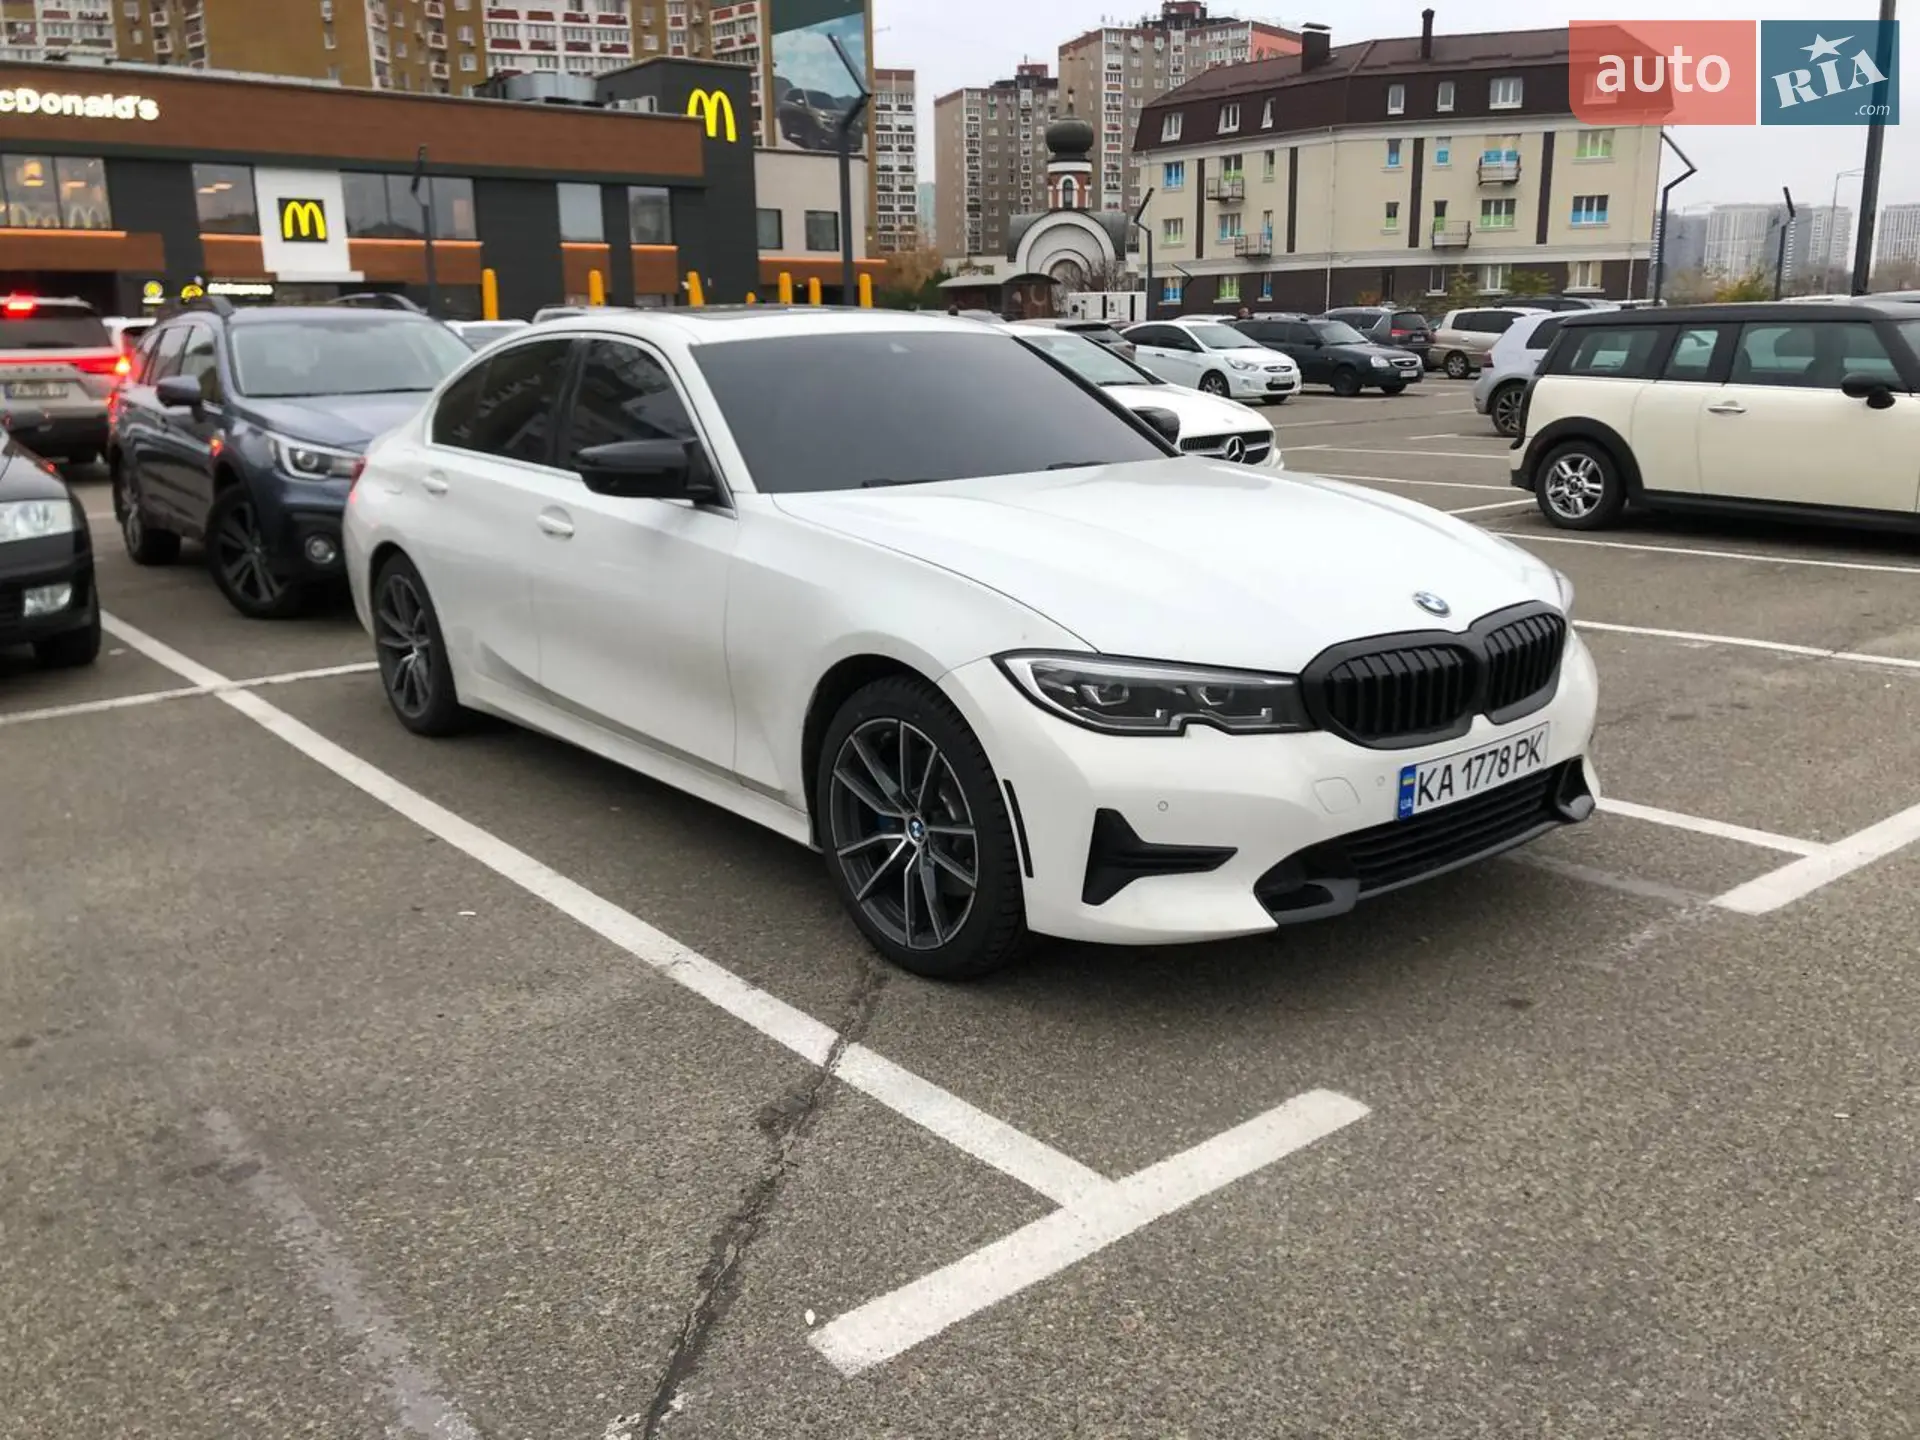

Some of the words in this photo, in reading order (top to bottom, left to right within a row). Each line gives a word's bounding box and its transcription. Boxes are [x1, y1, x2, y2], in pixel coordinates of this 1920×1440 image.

[0, 87, 160, 121] cDonald's
[1417, 763, 1454, 806] KA
[1461, 745, 1511, 791] 1778
[1513, 731, 1544, 774] PK
